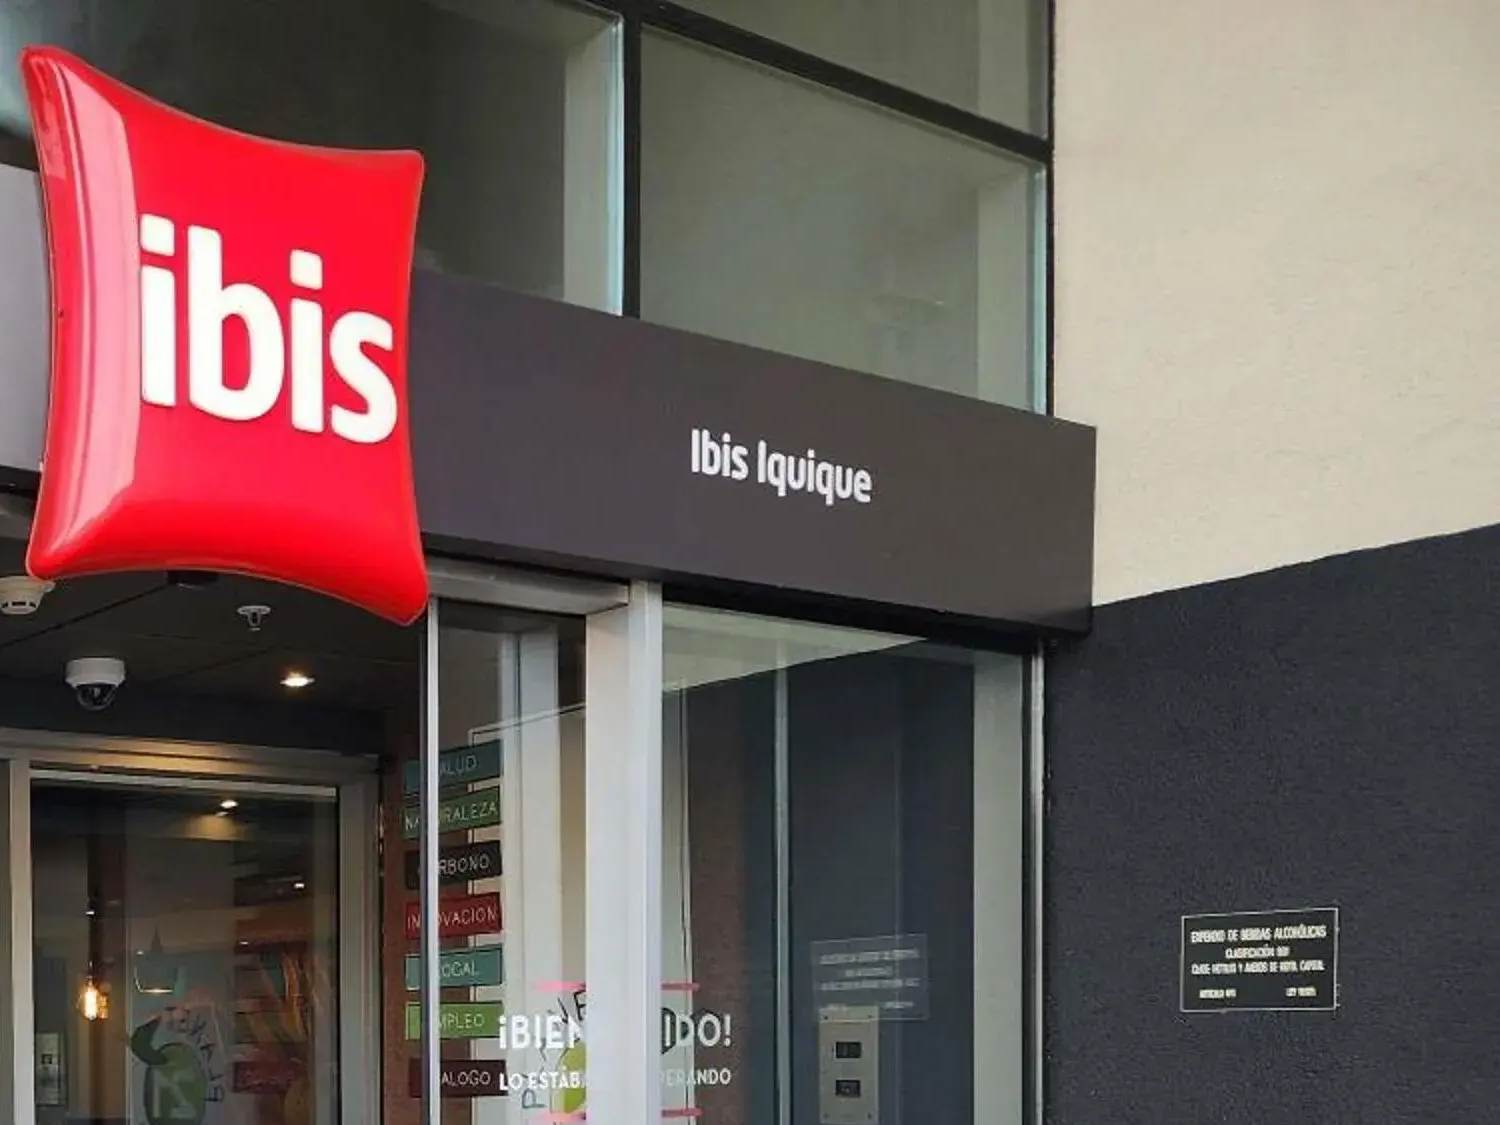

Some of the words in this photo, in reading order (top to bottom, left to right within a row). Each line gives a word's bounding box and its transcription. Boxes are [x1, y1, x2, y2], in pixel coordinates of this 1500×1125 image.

[140, 214, 398, 444] ibis
[691, 428, 749, 480] Ibis
[757, 440, 872, 505] Iquique
[439, 754, 478, 777] ALUD
[405, 802, 498, 831] NARALEZA
[418, 853, 490, 875] RBONO
[407, 907, 498, 929] INVACION
[441, 962, 478, 977] OCAL
[439, 1013, 485, 1028] MPLEO
[441, 1070, 491, 1087] ALOGO
[500, 1072, 523, 1091] LO
[528, 1066, 587, 1088] ESTÁB
